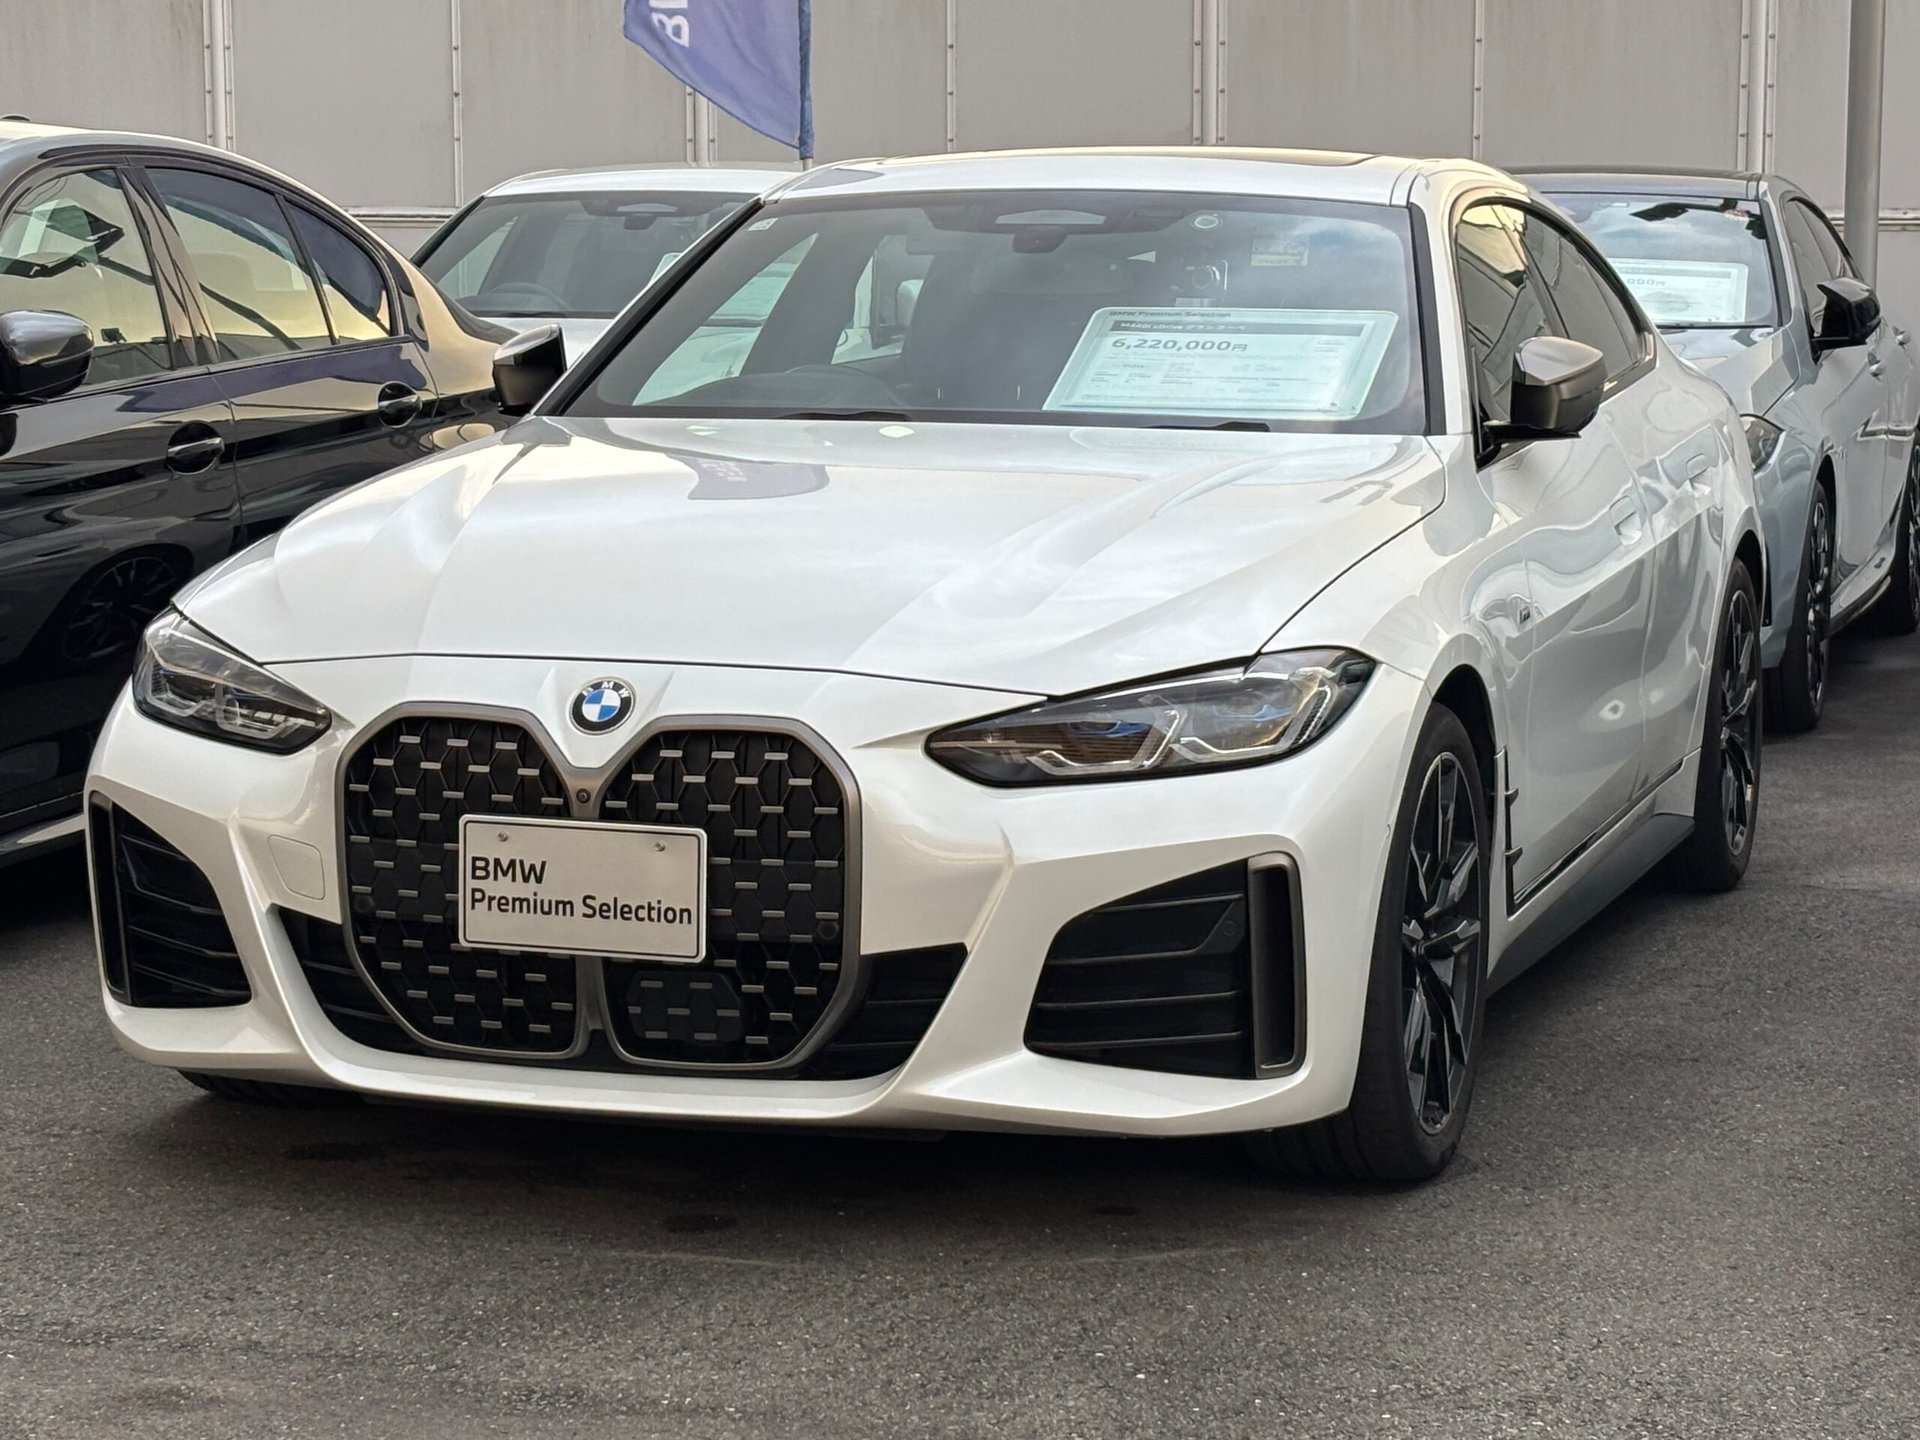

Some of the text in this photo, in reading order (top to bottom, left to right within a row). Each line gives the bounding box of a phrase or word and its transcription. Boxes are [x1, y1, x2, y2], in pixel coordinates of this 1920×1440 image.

[1112, 338, 1248, 352] 6,220,000円
[582, 681, 630, 698] BMW
[470, 855, 547, 885] BMW
[470, 887, 692, 925] Premium Selection
